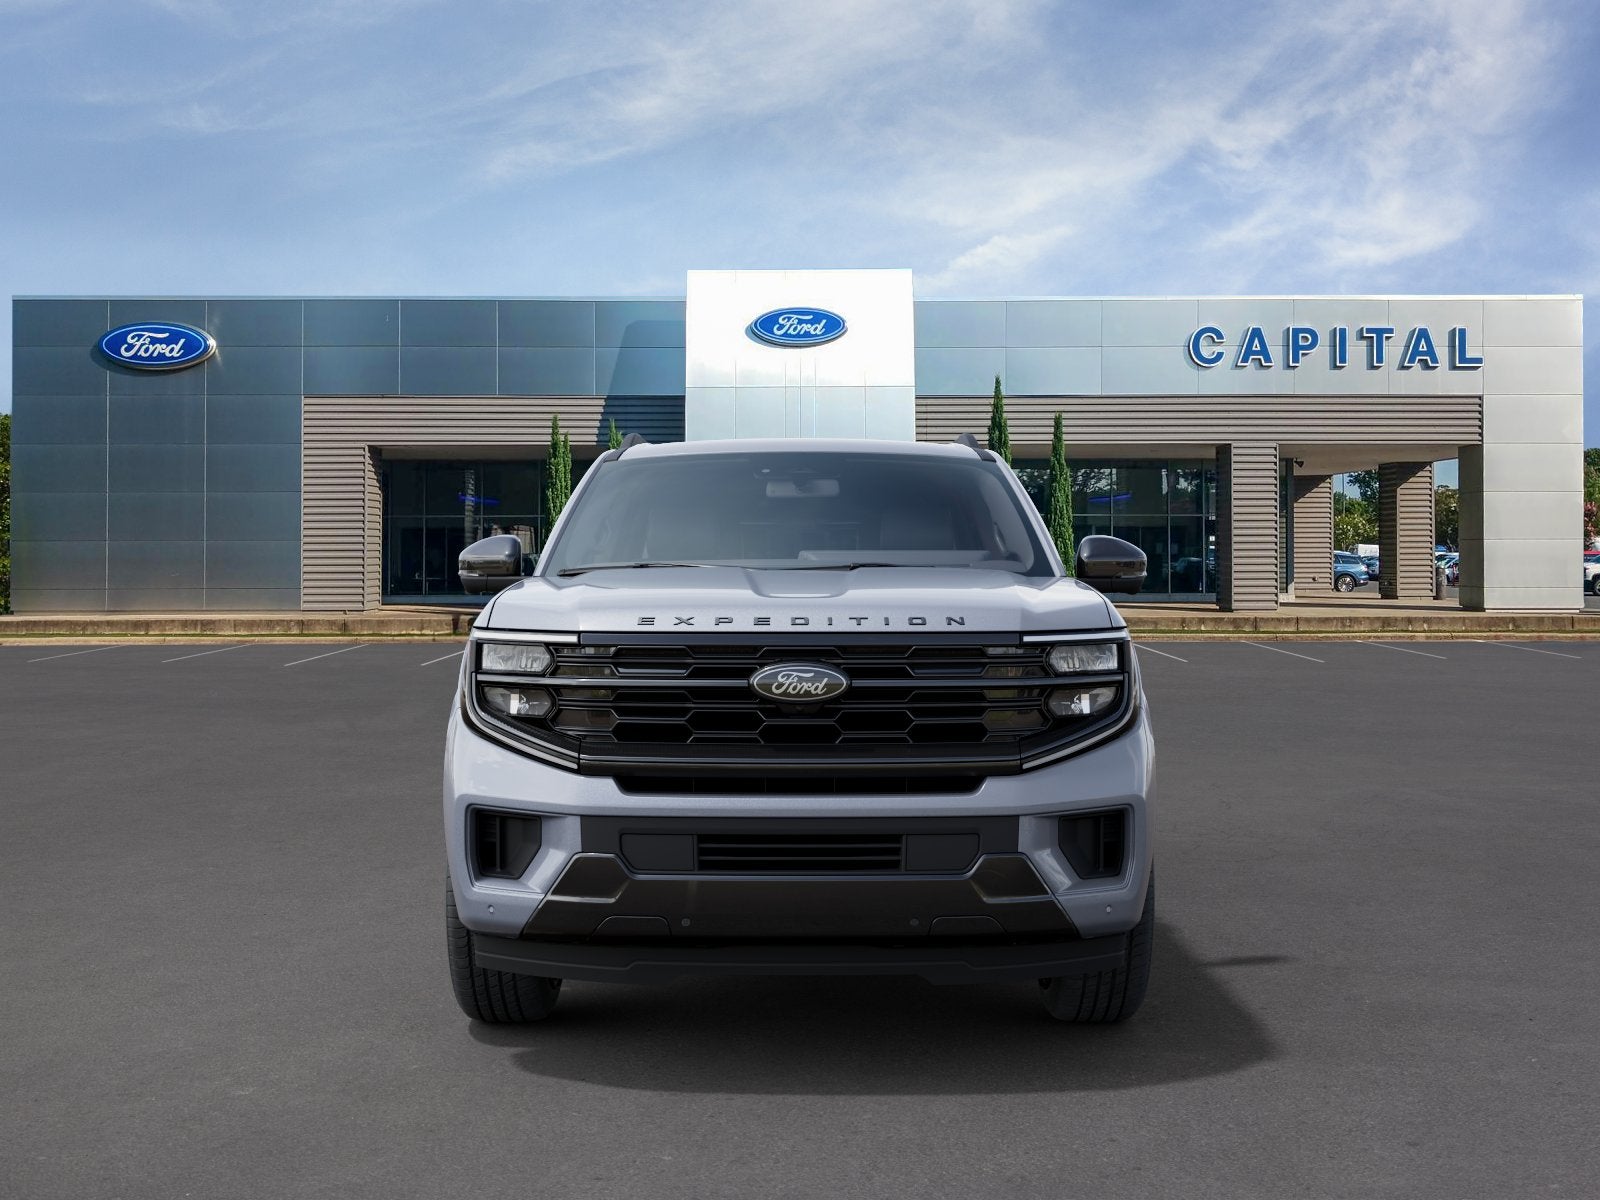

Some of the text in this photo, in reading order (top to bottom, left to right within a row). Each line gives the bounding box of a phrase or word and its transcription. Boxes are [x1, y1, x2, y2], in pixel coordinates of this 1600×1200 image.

[773, 314, 827, 335] Ford
[120, 331, 186, 358] Ford
[1189, 325, 1485, 368] CAPITAL
[637, 616, 966, 626] EXPEDITION
[771, 671, 827, 695] Ford
